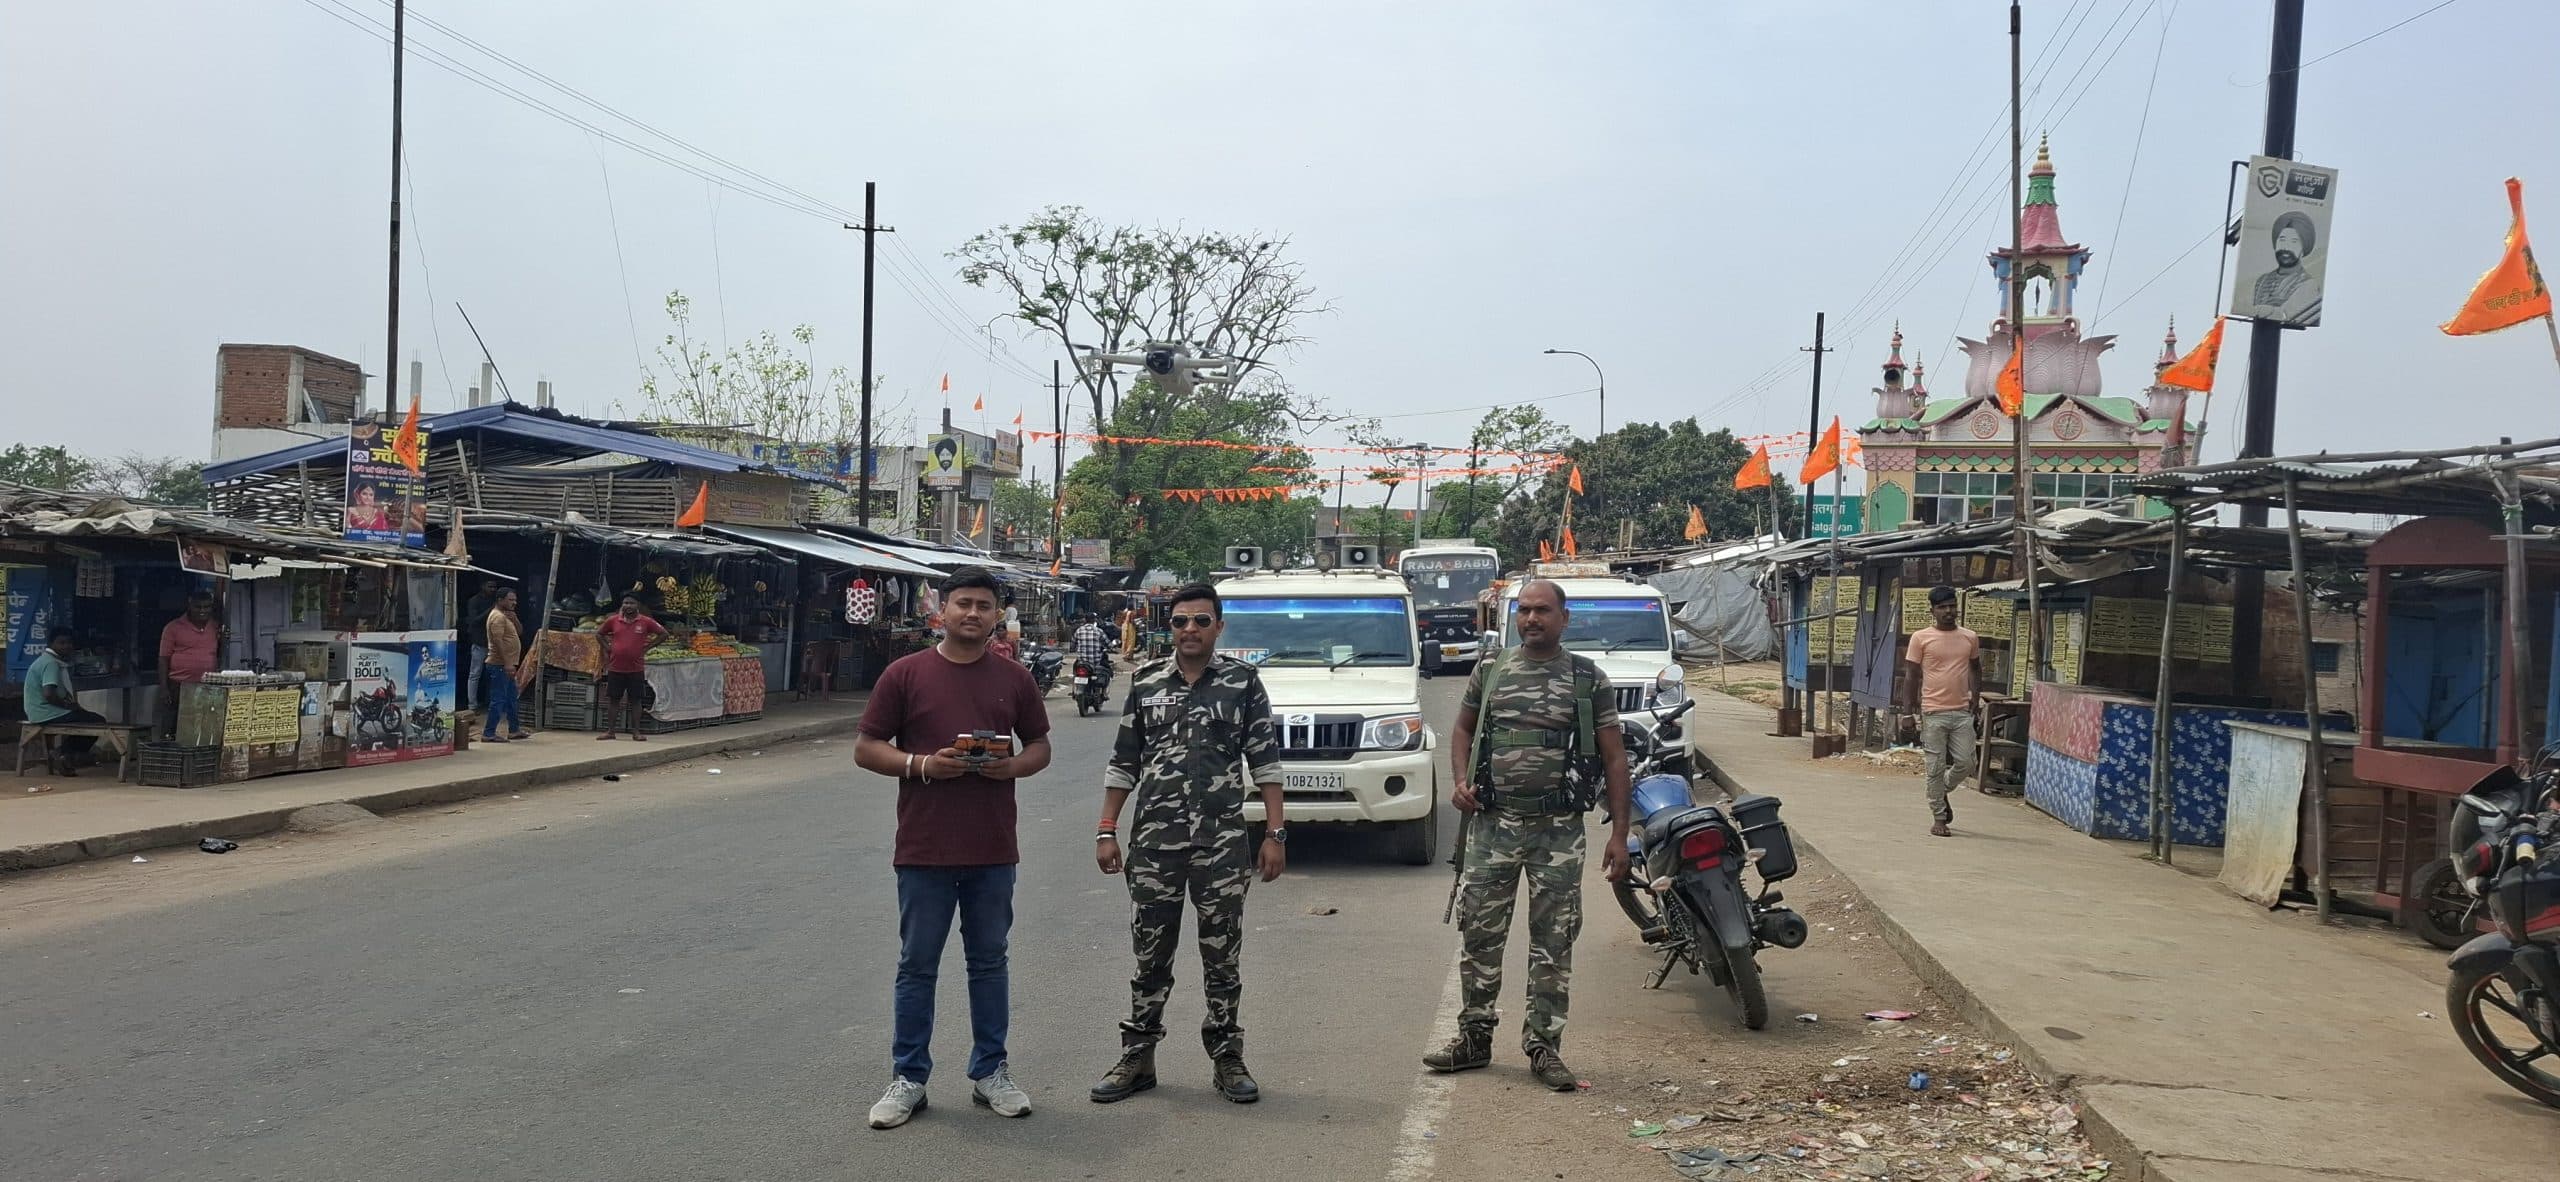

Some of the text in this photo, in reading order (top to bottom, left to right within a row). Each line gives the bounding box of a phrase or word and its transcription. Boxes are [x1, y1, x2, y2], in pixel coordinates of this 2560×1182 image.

[380, 426, 429, 446] संम
[1407, 559, 1490, 570] RAJA BABU
[354, 667, 381, 678] BOLD
[1286, 775, 1342, 787] 10BZ1321
